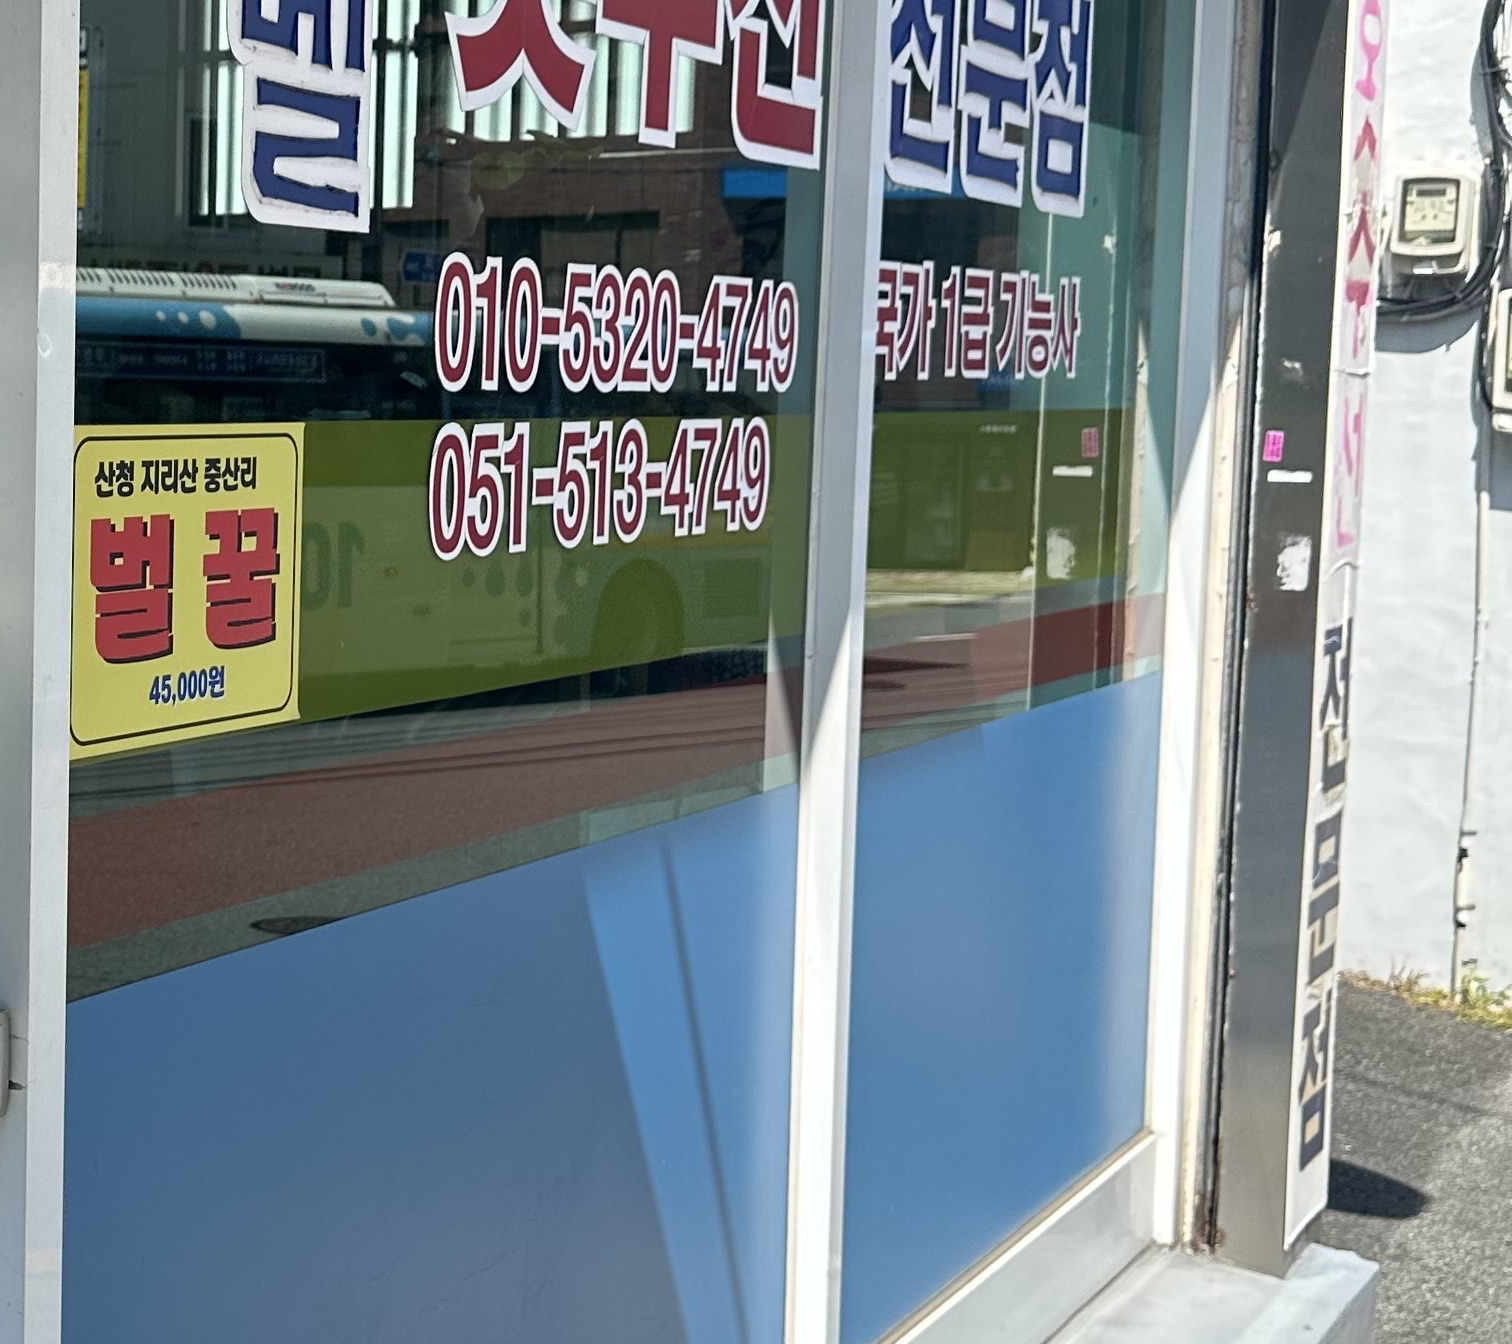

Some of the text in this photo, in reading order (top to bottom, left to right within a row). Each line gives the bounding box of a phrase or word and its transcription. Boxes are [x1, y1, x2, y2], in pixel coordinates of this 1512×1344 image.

[434, 251, 799, 393] 010-5320-4749
[941, 265, 994, 379] 1급
[995, 270, 1081, 379] 기능사
[95, 456, 258, 498] 산청 지리산 중산리
[429, 416, 771, 561] 051-513-4749
[149, 665, 226, 706] 45,000원
